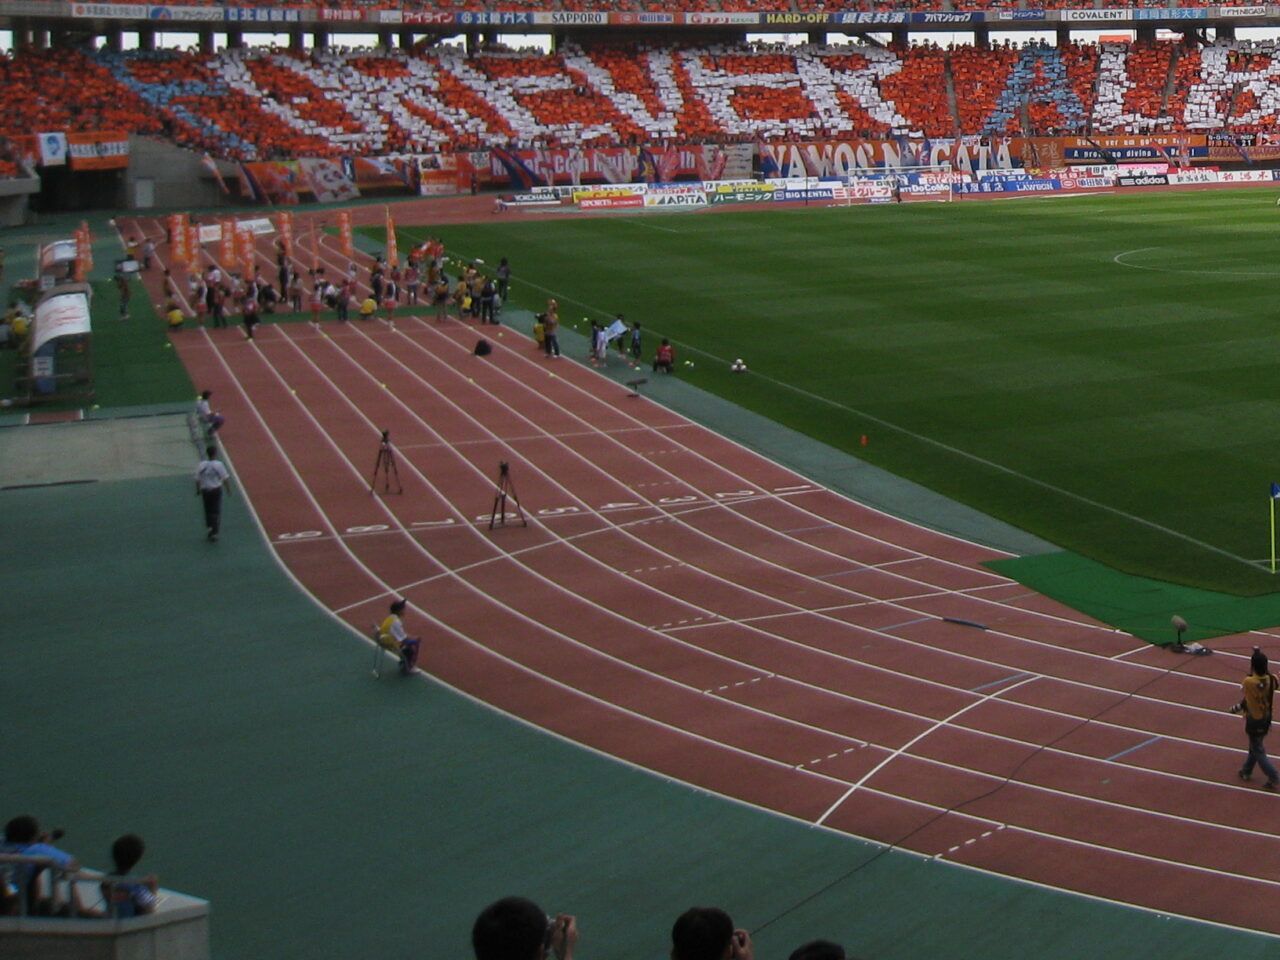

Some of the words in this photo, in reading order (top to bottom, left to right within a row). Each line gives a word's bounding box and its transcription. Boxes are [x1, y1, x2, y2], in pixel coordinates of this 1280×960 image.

[551, 13, 602, 23] SAPPORO
[1071, 11, 1123, 20] COVALENT
[881, 139, 1013, 176] NGATA
[1136, 176, 1166, 185] adidas
[911, 184, 950, 192] DoCoMo
[1016, 183, 1054, 191] LAWSON
[714, 191, 773, 202] ハーモニック
[785, 190, 801, 199] BIG
[801, 190, 833, 199] RENTAL
